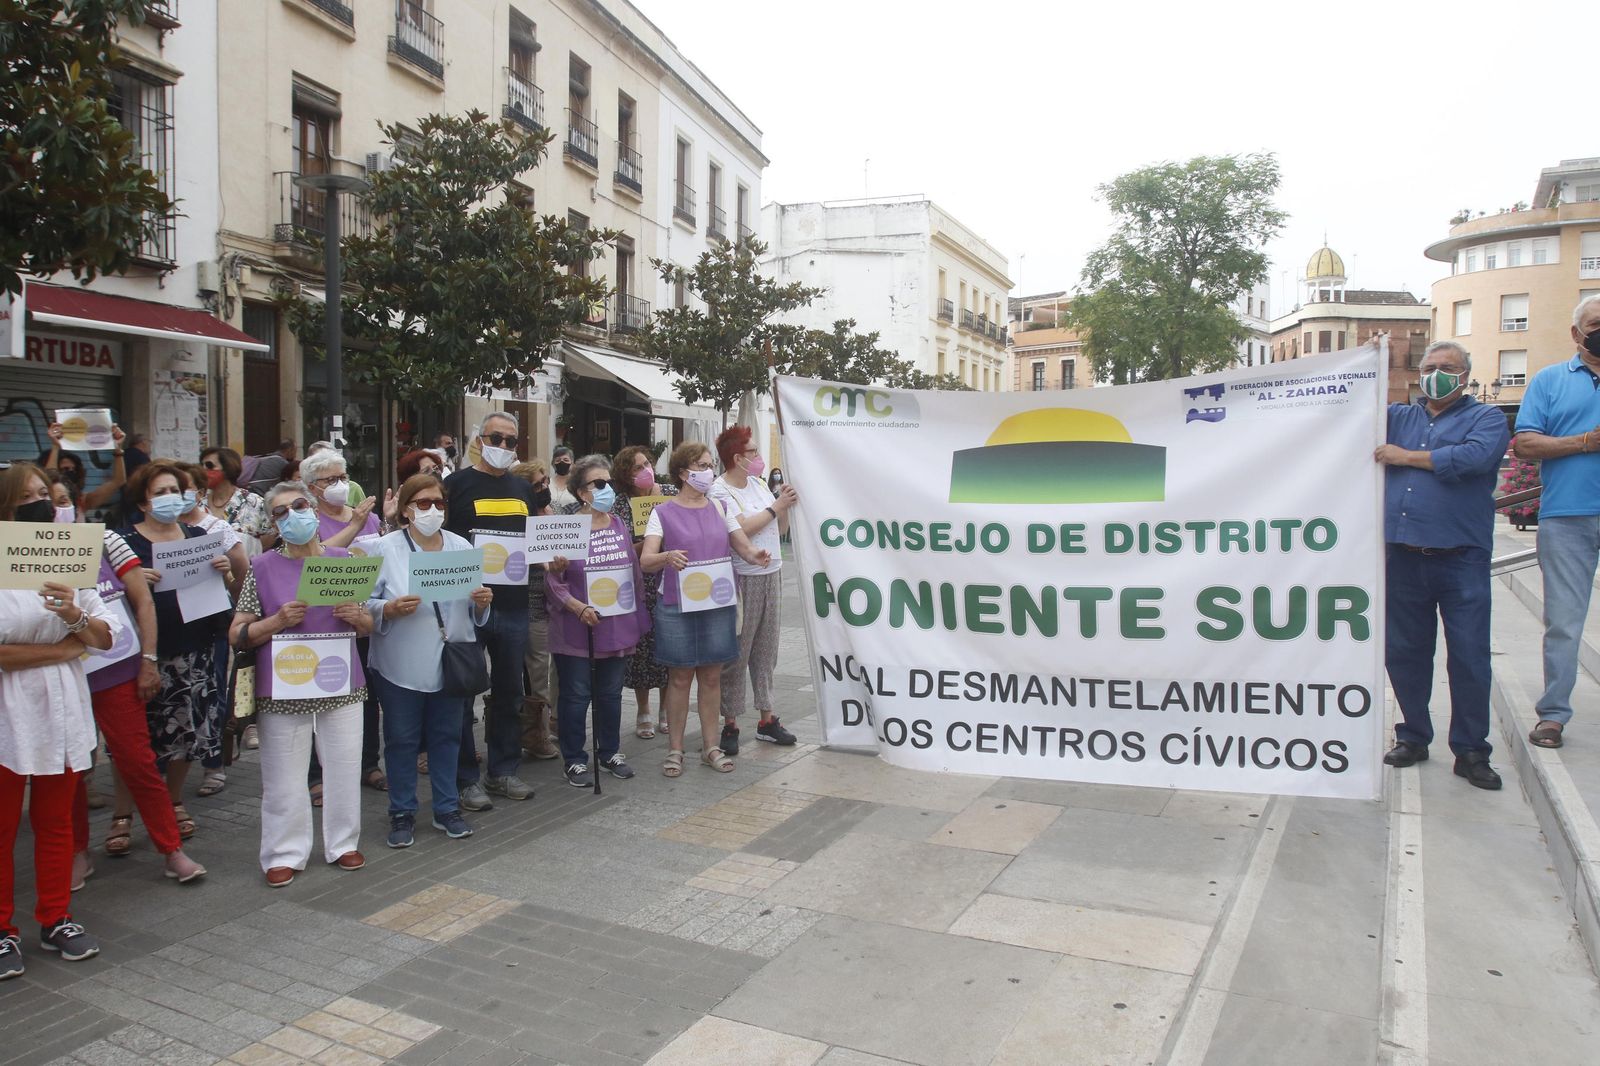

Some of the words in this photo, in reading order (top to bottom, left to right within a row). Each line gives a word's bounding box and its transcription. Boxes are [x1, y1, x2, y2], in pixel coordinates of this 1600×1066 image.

[25, 335, 115, 369] RTUBA
[1230, 381, 1273, 390] FEDERACIÓN
[1285, 374, 1337, 386] ASOCIACIONES
[1338, 371, 1376, 380] VECINALES
[791, 419, 815, 428] consejo
[816, 419, 828, 427] del
[830, 420, 876, 428] movimiento
[878, 421, 920, 429] ciudadano
[550, 522, 581, 530] CENTROS
[35, 530, 54, 540] NO
[58, 531, 71, 540] ES
[536, 533, 563, 541] CÍVICOS
[820, 518, 1010, 554] CONSEJO
[1027, 523, 1087, 554] DE
[1104, 517, 1338, 554] DISTRITO
[7, 546, 75, 556] MOMENTO
[78, 547, 93, 556] DE
[156, 547, 193, 559] CENTROS
[194, 540, 222, 553] CÍVICOS
[528, 544, 549, 552] CASAS
[166, 553, 214, 569] REFORZADOS
[10, 563, 87, 573] RETROCESOS
[345, 565, 377, 574] QUITEN
[413, 564, 480, 576] CONTRATACIONES
[310, 577, 327, 585] LOS
[329, 577, 369, 585] CENTROS
[421, 578, 455, 588] MASIVAS
[457, 577, 472, 585] ¡YA!
[319, 588, 355, 597] CÍVICOS
[812, 571, 1166, 640] PONIENTE
[1196, 585, 1370, 641] SUR
[909, 668, 1371, 718] DESMANTELAMIENTO
[878, 717, 933, 749] OS
[946, 721, 1146, 763] CENTROS
[1160, 726, 1349, 774] CÍVICOS
